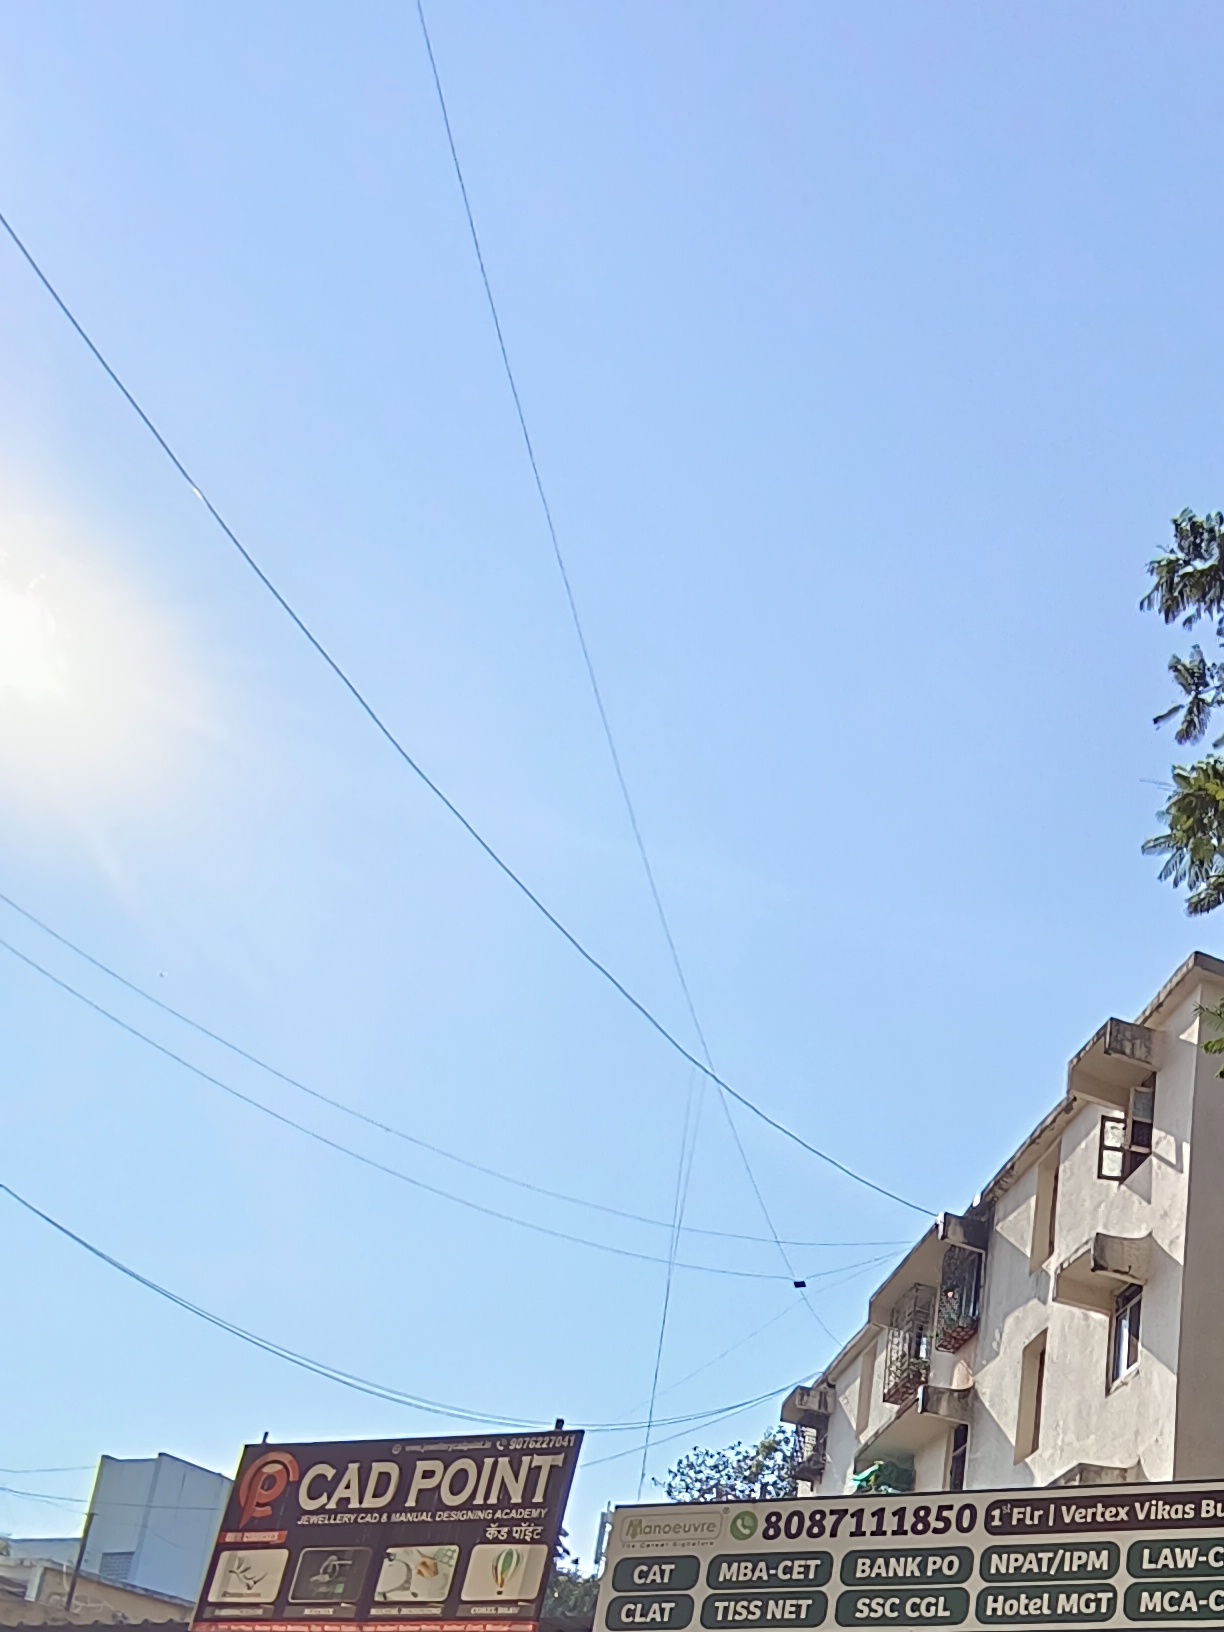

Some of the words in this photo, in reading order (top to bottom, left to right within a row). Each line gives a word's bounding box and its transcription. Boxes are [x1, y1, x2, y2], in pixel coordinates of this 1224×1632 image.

[299, 1461, 400, 1511] CAD
[404, 1452, 565, 1507] POINT
[297, 1512, 357, 1525] JEWELLERY
[357, 1512, 380, 1524] CAD
[381, 1513, 387, 1522] &
[390, 1510, 433, 1522] MANUAL
[435, 1509, 493, 1521] DESIGNING
[494, 1508, 548, 1520] ACADEMY
[625, 1518, 716, 1537] Manoeuvre
[762, 1503, 978, 1541] 8087111850
[718, 1559, 820, 1582] MBA-CET
[855, 1556, 923, 1579] BANK
[926, 1554, 960, 1576] PO
[990, 1549, 1109, 1574] NPAT/IPM
[633, 1564, 675, 1585] CAT
[620, 1602, 675, 1623] CLAT
[714, 1599, 761, 1621] TISS
[766, 1598, 812, 1620] NET
[855, 1597, 899, 1619] SSC
[905, 1596, 950, 1619] CGL
[985, 1593, 1050, 1617] Hotel
[1057, 1592, 1113, 1614] MGT
